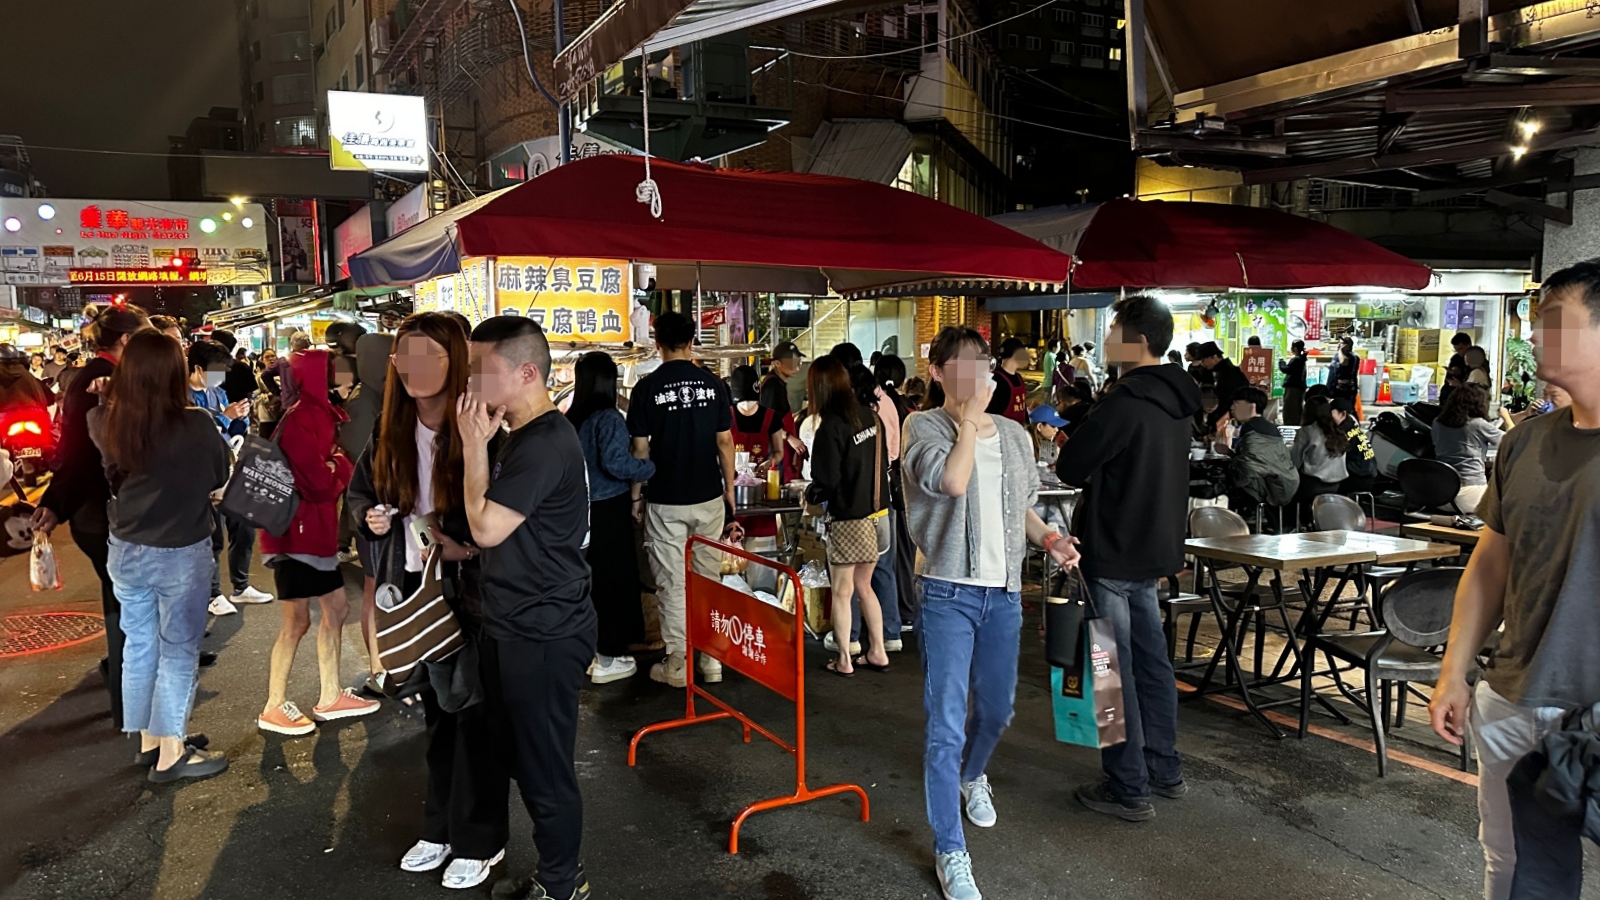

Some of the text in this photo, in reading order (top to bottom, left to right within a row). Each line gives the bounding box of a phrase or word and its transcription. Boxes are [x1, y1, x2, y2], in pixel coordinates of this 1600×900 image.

[498, 264, 621, 294] 麻辣臭豆腐
[695, 387, 716, 400] 塗料
[242, 465, 264, 482] WAVE
[710, 609, 766, 653] 請勿 停車
